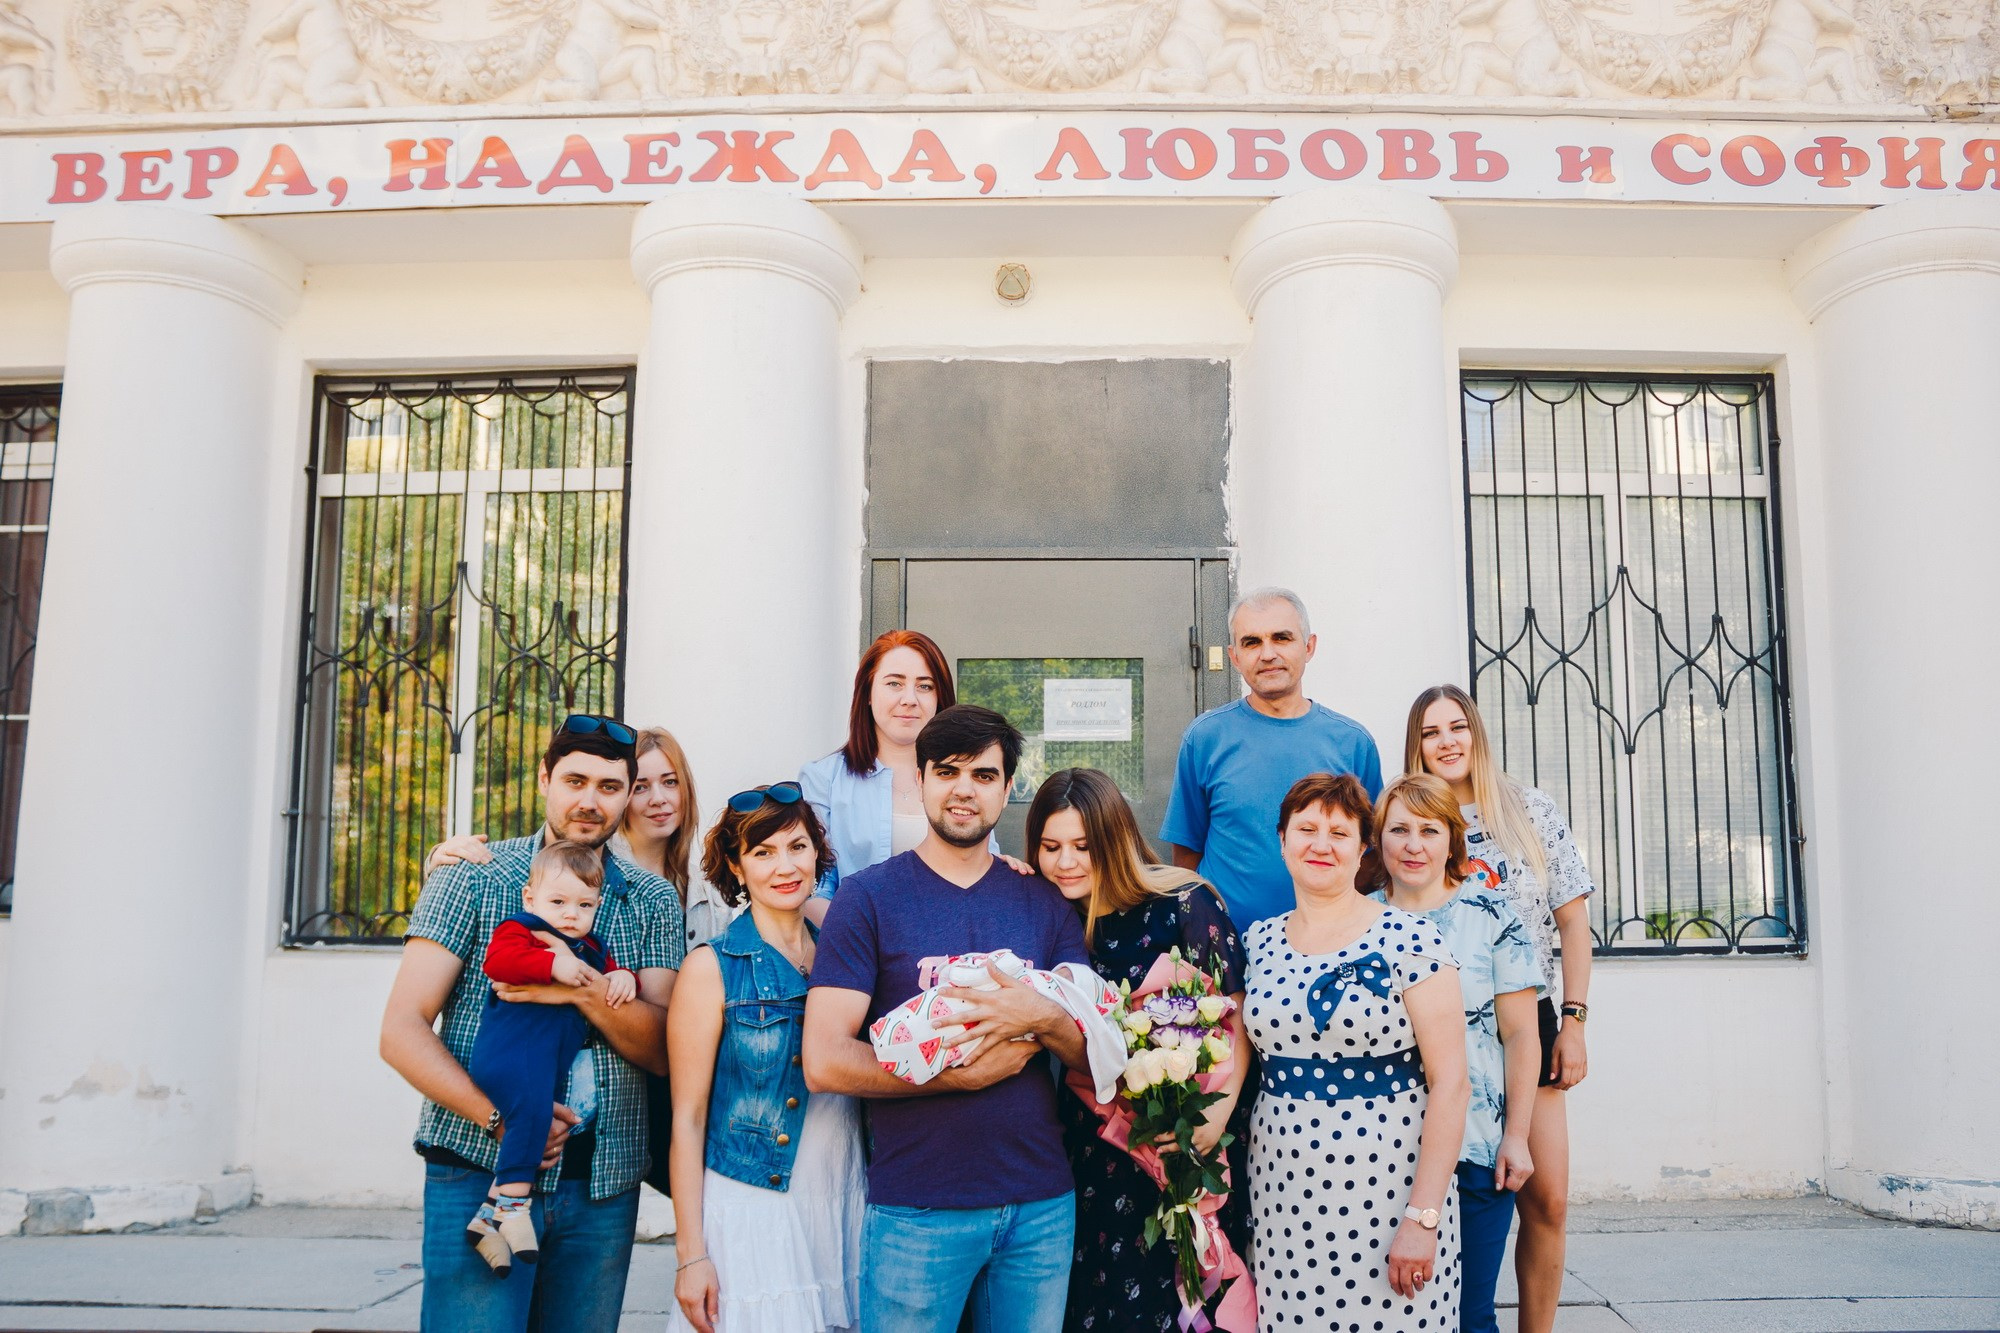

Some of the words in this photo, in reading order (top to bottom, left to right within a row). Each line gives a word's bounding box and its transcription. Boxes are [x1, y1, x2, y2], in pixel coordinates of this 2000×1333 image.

[48, 144, 349, 207] ВЕРА,
[383, 127, 998, 195] НАДЕЖДА,
[1034, 126, 1510, 184] ЛЮБОВЬ
[1556, 145, 1617, 184] и
[1651, 132, 2000, 192] СОФИЯ
